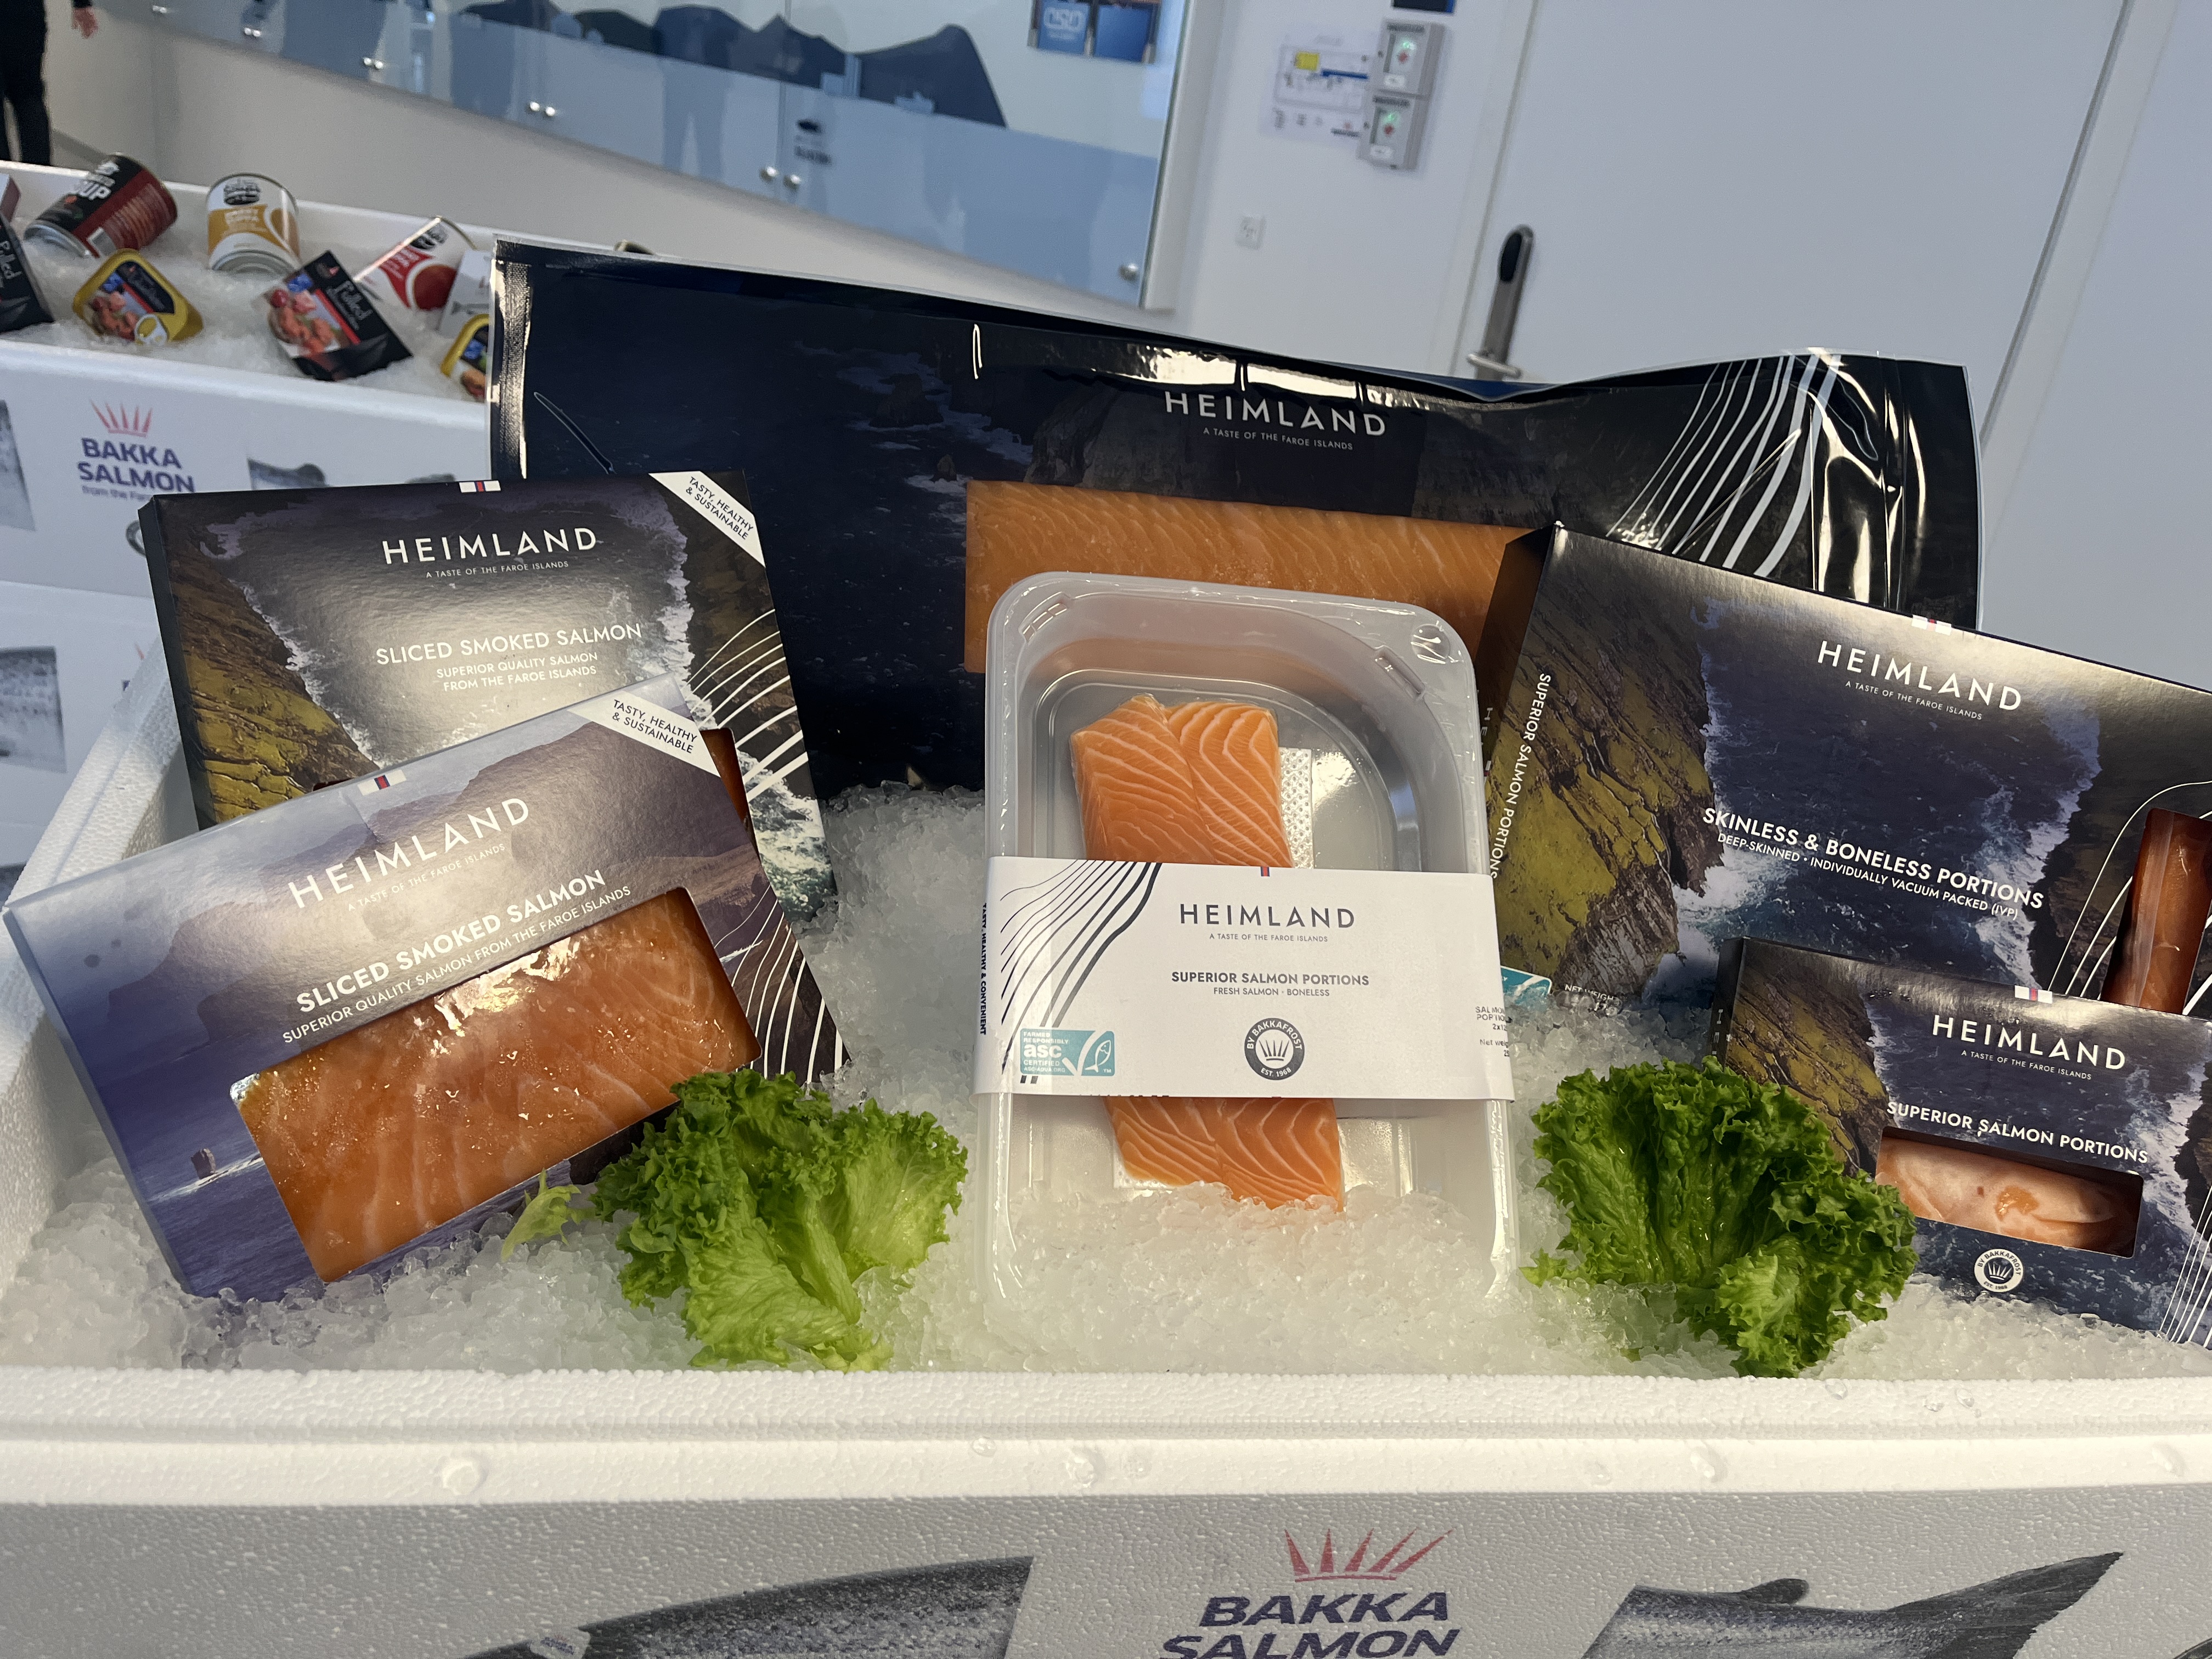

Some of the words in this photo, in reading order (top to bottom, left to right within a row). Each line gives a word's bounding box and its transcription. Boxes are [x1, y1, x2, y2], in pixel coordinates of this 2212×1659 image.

[1165, 391, 1386, 436] HEIMLAND
[81, 437, 183, 469] BAKKA
[1214, 428, 1239, 439] TASTE
[1261, 433, 1278, 441] THE
[1282, 436, 1310, 446] FAROE
[1313, 440, 1353, 450] ISLANDS
[77, 461, 196, 493] SALMON
[686, 487, 693, 495] &
[695, 493, 748, 540] SUSTAINABLE
[690, 476, 715, 502] TASTY,
[716, 499, 754, 531] HEALTHY
[382, 528, 596, 565] HEIMLAND
[435, 569, 461, 578] TASTE
[501, 564, 528, 572] FAROE
[532, 561, 569, 569] ISLANDS
[376, 642, 452, 665] SLICED
[460, 632, 549, 656] SMOKED
[556, 623, 642, 646] SALMON
[437, 663, 494, 678] SUPERIOR
[498, 658, 545, 672] QUALITY
[550, 652, 598, 666] SALMON
[443, 679, 478, 692] FROM
[481, 675, 504, 687] THE
[508, 672, 545, 684] FAROE
[549, 665, 597, 679] ISLANDS
[1818, 641, 2021, 710] HEIMLAND
[613, 699, 645, 722] TASTY,
[650, 716, 697, 742] HEALTHY
[1522, 673, 1551, 742] SUPERIOR
[1855, 682, 1878, 695] TASTE
[1882, 690, 1894, 698] OF
[1897, 693, 1912, 703] THE
[1916, 698, 1943, 710] FAROE
[1946, 705, 1982, 720] ISLANDS
[612, 712, 620, 721] &
[624, 717, 693, 753] SUSTAINABLE
[1506, 744, 1532, 805] SALMON
[288, 798, 529, 909] HEIMLAND
[1490, 808, 1515, 879] PORTIONS
[1702, 808, 1799, 845] SKINLESS
[1804, 834, 1819, 851] &
[1825, 839, 1932, 880] BONELESS
[1937, 868, 2044, 909] PORTIONS
[348, 902, 356, 912] A
[357, 889, 388, 906] TASTE
[391, 882, 405, 894] OF
[408, 873, 427, 888] THE
[430, 861, 462, 879] FAROE
[465, 843, 505, 864] ISLANDS
[1718, 833, 1800, 862] DEEP-SKINNED
[1810, 856, 1888, 885] INDIVIDUALLY
[1892, 877, 1940, 899] VACUUM
[1942, 891, 1988, 911] PACKED
[1991, 903, 2018, 921] (IVP)
[1181, 904, 1355, 928] HEIMLAND
[296, 961, 390, 1013] SLICED
[395, 914, 501, 970] SMOKED
[506, 869, 606, 923] SALMON
[282, 1008, 353, 1044] SUPERIOR
[356, 980, 413, 1012] QUALITY
[415, 953, 473, 986] SALMON
[475, 937, 512, 961] FROM
[512, 928, 538, 947] THE
[539, 909, 580, 935] FAROE
[581, 885, 631, 916] ISLANDS
[1171, 972, 1237, 983] SUPERIOR
[1242, 973, 1297, 984] SALMON
[1303, 974, 1369, 986] PORTIONS
[1287, 989, 1330, 997] BONELESS
[1024, 1043, 1062, 1058] asc
[1246, 1036, 1255, 1049] BY
[1252, 1020, 1302, 1050] BAKKAFROST
[1933, 1015, 2125, 1070] HEIMLAND
[1261, 1068, 1273, 1077] EST.
[1276, 1068, 1291, 1077] 1968
[1971, 1051, 1994, 1062] TASTE
[2011, 1059, 2025, 1068] THE
[2029, 1062, 2055, 1073] FAROE
[2058, 1068, 2092, 1080] ISLANDS
[1886, 1101, 1972, 1130] SUPERIOR
[1979, 1119, 2054, 1146] SALMON
[2059, 1134, 2148, 1164] PORTIONS
[1977, 1259, 1985, 1267] BY
[1984, 1251, 2021, 1275] BAKKAFROST
[1199, 1592, 1448, 1627] BAKKA
[1159, 1628, 1463, 1659] SALMON
